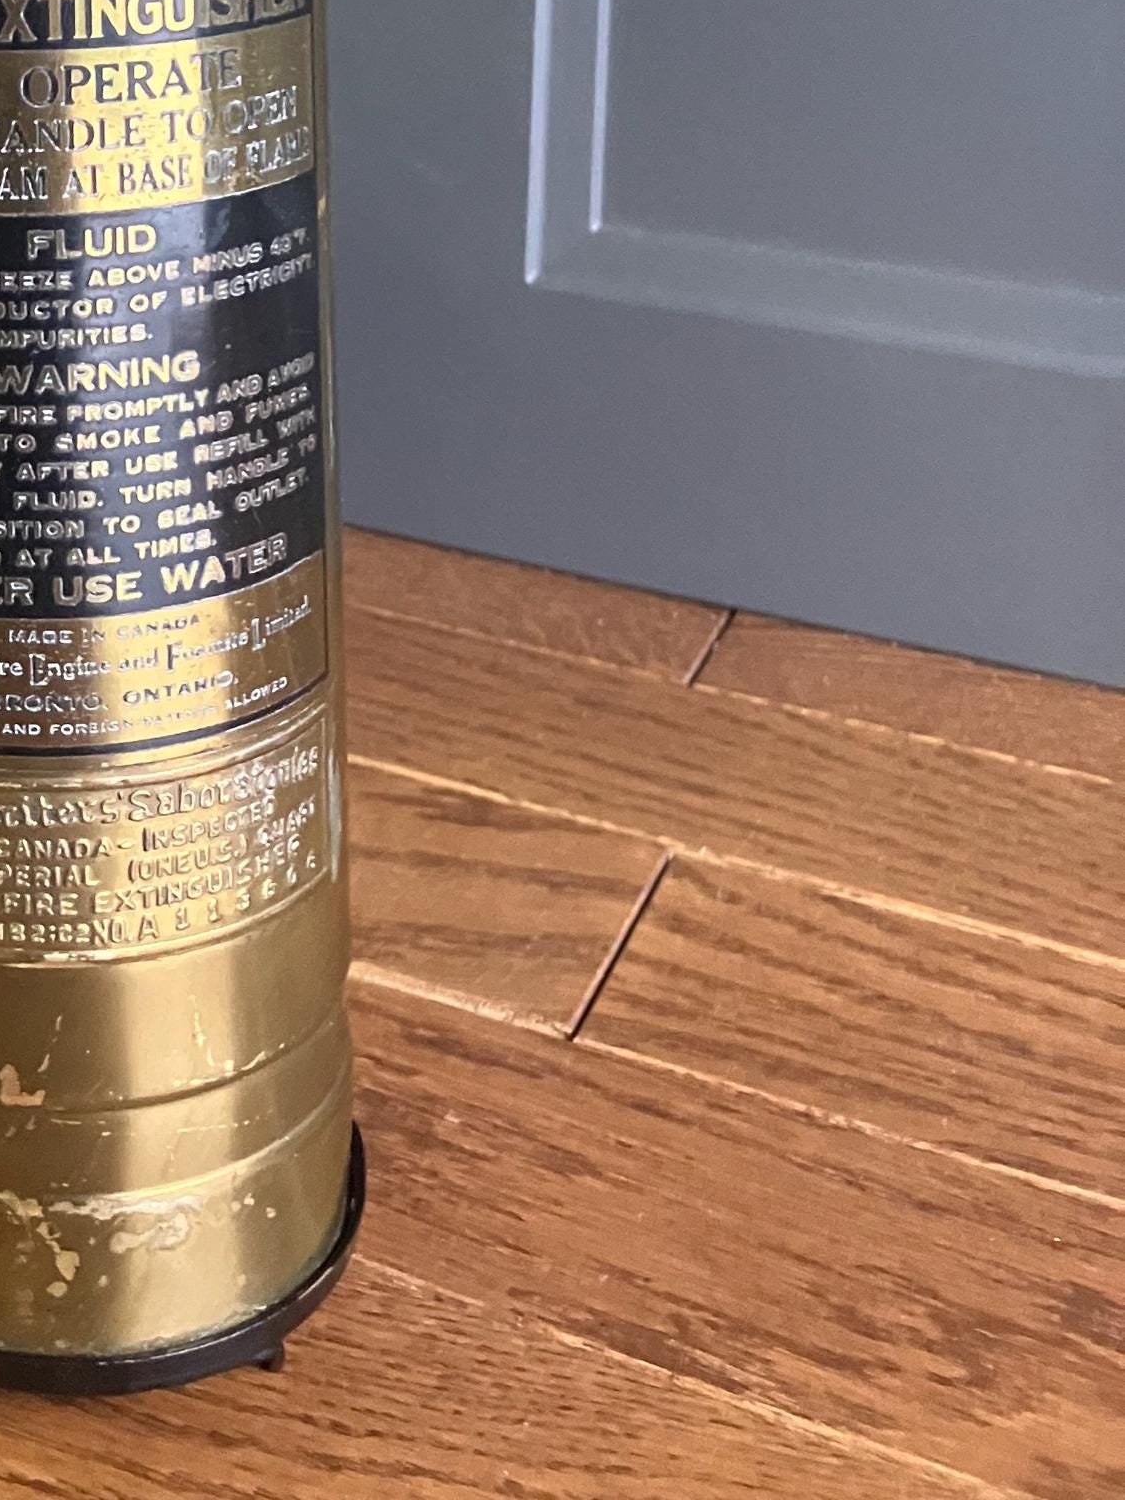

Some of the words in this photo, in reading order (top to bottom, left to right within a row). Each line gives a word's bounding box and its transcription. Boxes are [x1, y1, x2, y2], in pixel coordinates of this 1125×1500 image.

[20, 48, 242, 109] OPERATE
[160, 107, 212, 143] TO
[224, 85, 297, 135] OPEN
[62, 164, 104, 198] AT
[118, 154, 193, 196] BASE
[204, 146, 239, 184] OF
[27, 224, 157, 260] FLUID
[88, 260, 180, 287] ABOVE
[193, 242, 263, 274] MINUS
[129, 291, 167, 312] OF
[66, 388, 209, 423] PROMPTLY
[216, 373, 263, 404] AND
[267, 351, 315, 388] AVOID
[15, 459, 110, 483] AFTER
[125, 451, 178, 475] USE
[194, 429, 269, 466] REFILL
[276, 405, 316, 440] WITH
[54, 425, 162, 452] SMOKE
[179, 410, 234, 440] AND
[245, 382, 311, 424] FUMES
[13, 489, 104, 511] FLUID.
[119, 477, 192, 505] TURN
[206, 447, 290, 492] HANDLE
[298, 434, 317, 457] TO
[103, 514, 141, 535] TO
[158, 500, 223, 530] SEAL
[15, 548, 53, 569] AT
[66, 546, 121, 567] ALL
[134, 528, 217, 559] TIMES.
[52, 570, 143, 607] USE
[161, 531, 288, 595] WATER
[8, 629, 74, 644] MADE
[117, 613, 200, 640] CANADA
[29, 650, 110, 687] Engine
[119, 648, 159, 671] and
[2, 723, 41, 736] AND
[49, 719, 133, 736] FOREIGN
[224, 676, 288, 710] ALLOWED
[141, 794, 275, 852] INSPECTED
[3, 892, 79, 916] FIRE
[94, 833, 300, 913] EXTINGUISHER
